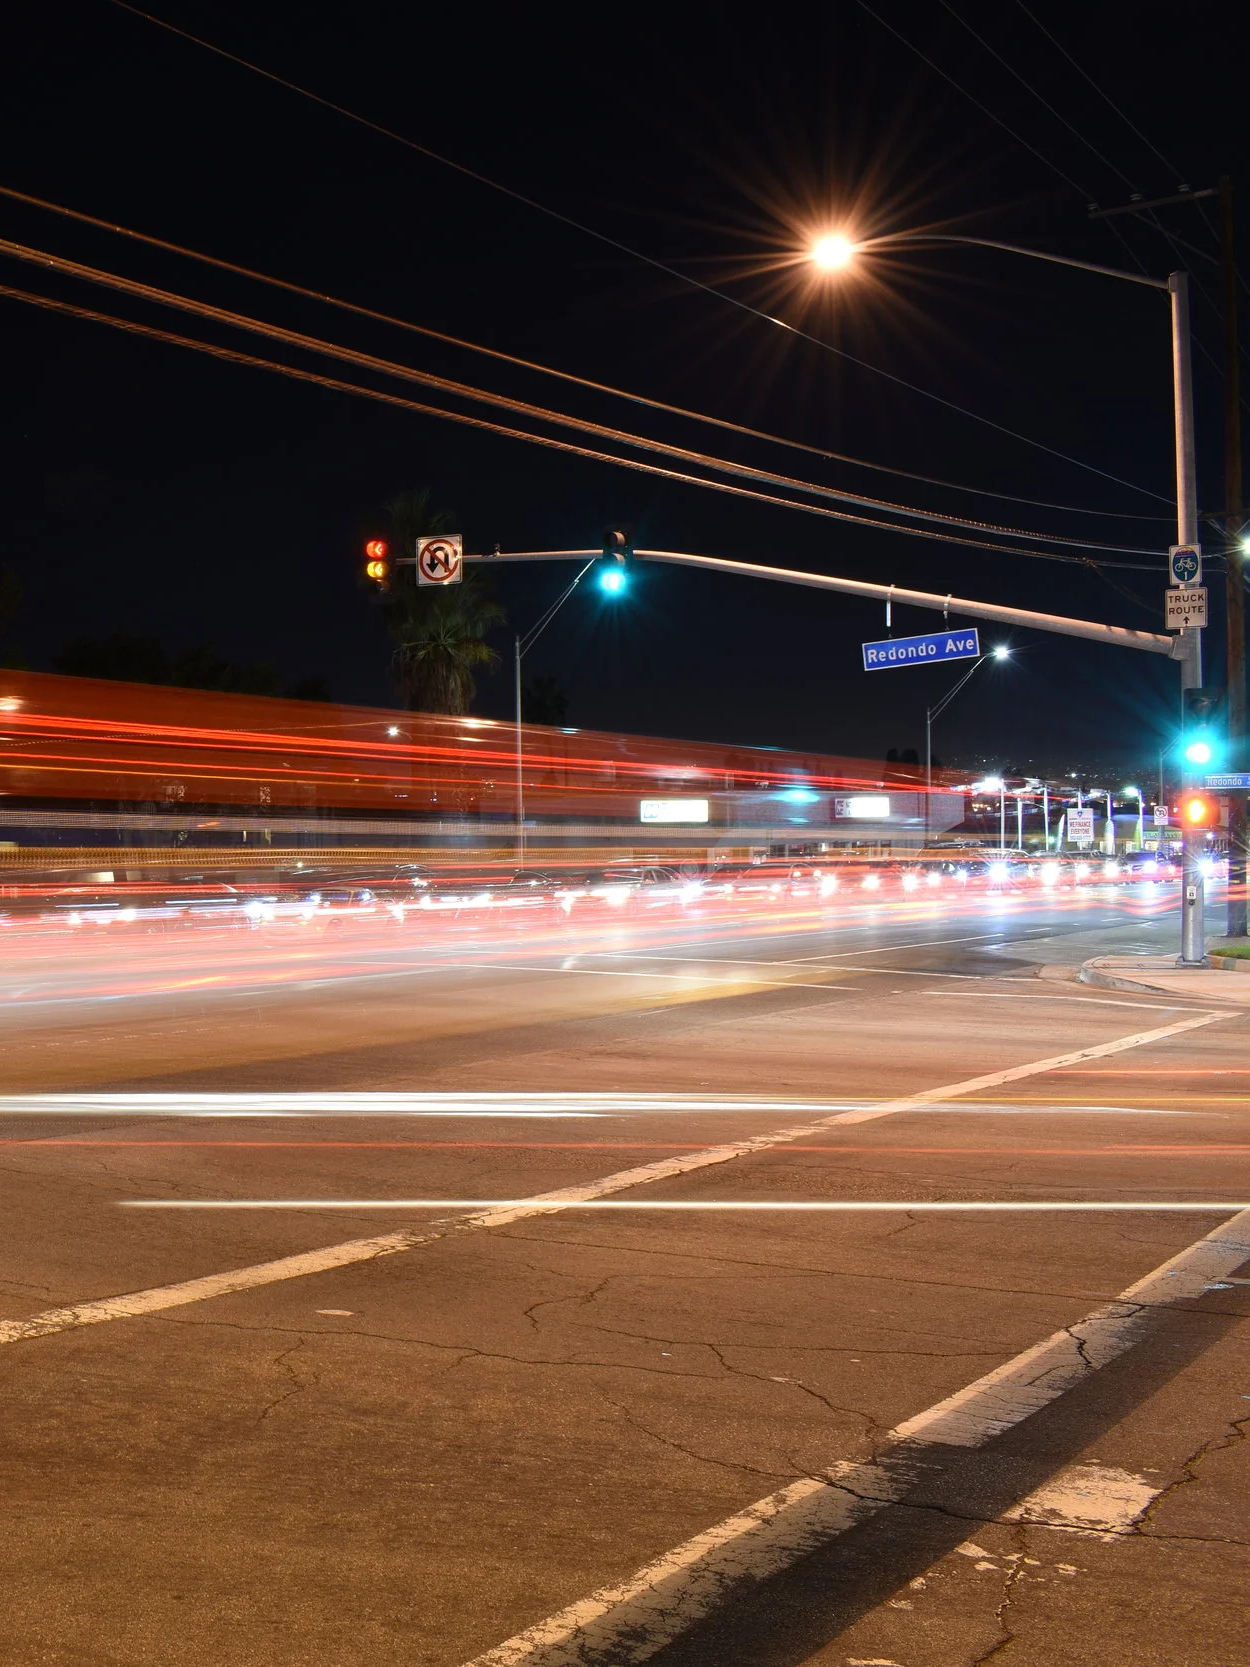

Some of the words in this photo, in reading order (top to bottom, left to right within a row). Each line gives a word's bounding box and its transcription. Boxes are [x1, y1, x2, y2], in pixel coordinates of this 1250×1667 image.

[1168, 593, 1205, 603] TRUCK
[1168, 605, 1205, 615] ROUTE
[867, 643, 937, 664] Redondo
[945, 638, 975, 653] Ave
[1207, 777, 1243, 786] Redondo
